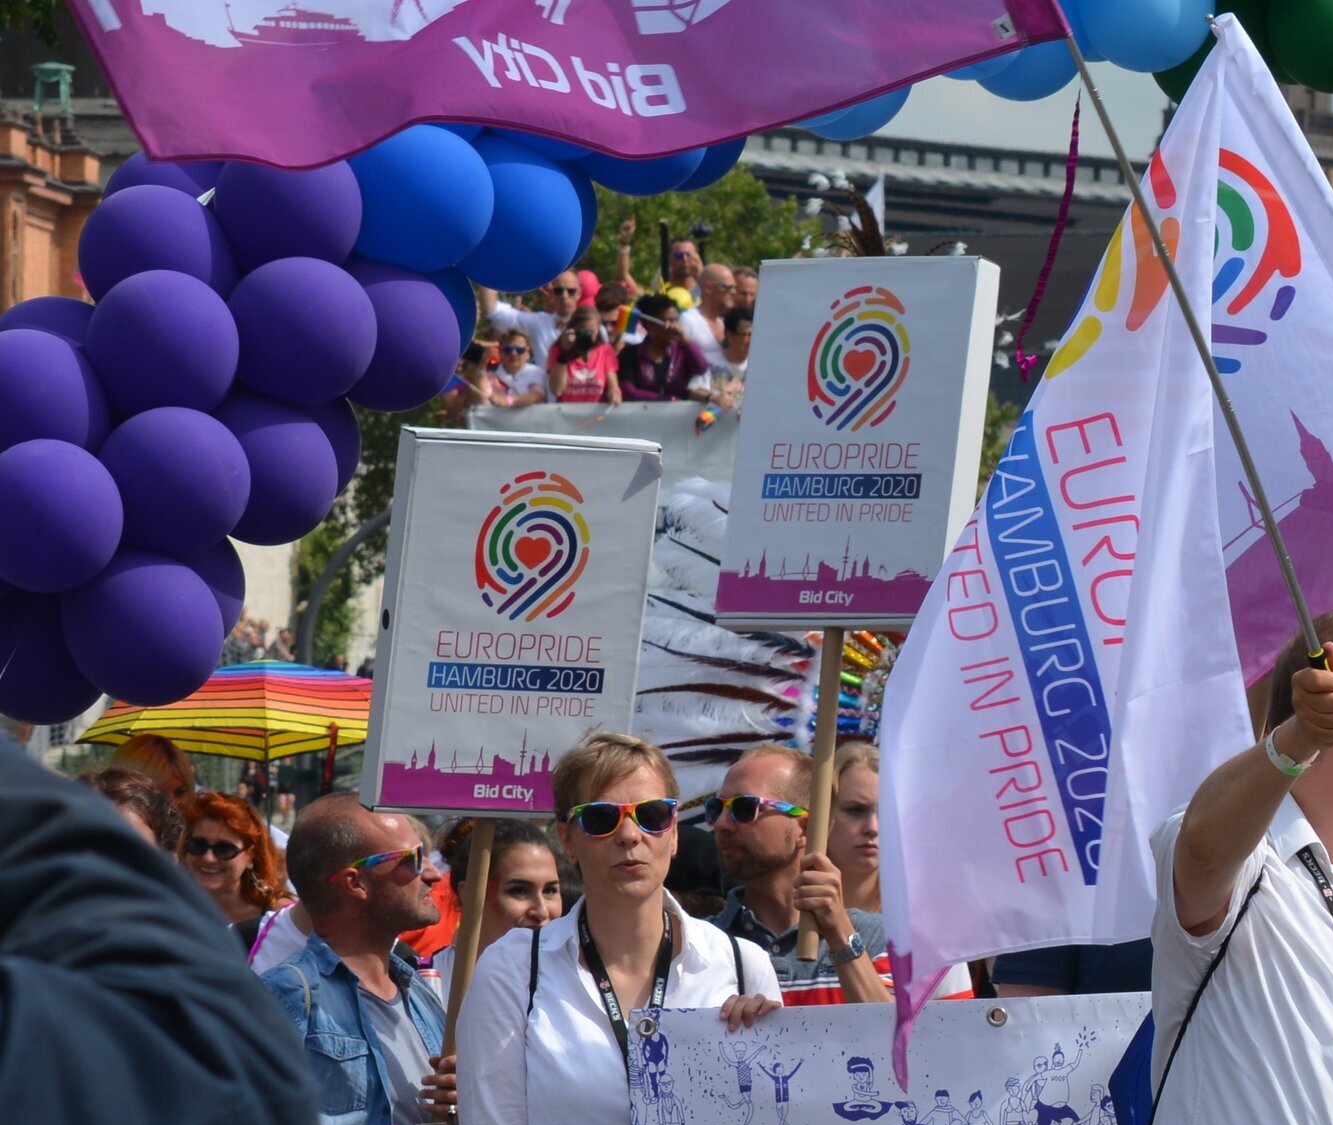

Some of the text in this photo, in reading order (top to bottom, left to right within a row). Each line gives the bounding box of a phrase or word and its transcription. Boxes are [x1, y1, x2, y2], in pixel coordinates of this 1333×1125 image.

[770, 442, 920, 470] EUROPRIDE
[765, 476, 917, 497] HAMBURG 2020
[763, 503, 913, 522] UNITED IN PRIDE
[991, 425, 1097, 717] HAMBURG
[799, 590, 854, 607] Bid City
[436, 630, 602, 663] EUROPRIDE
[431, 665, 600, 691] HAMBURG 2020
[960, 657, 1021, 711] IN
[430, 692, 596, 717] UNITED IN PRIDE
[473, 784, 534, 802] Bid City
[979, 725, 1069, 883] PRIDE
